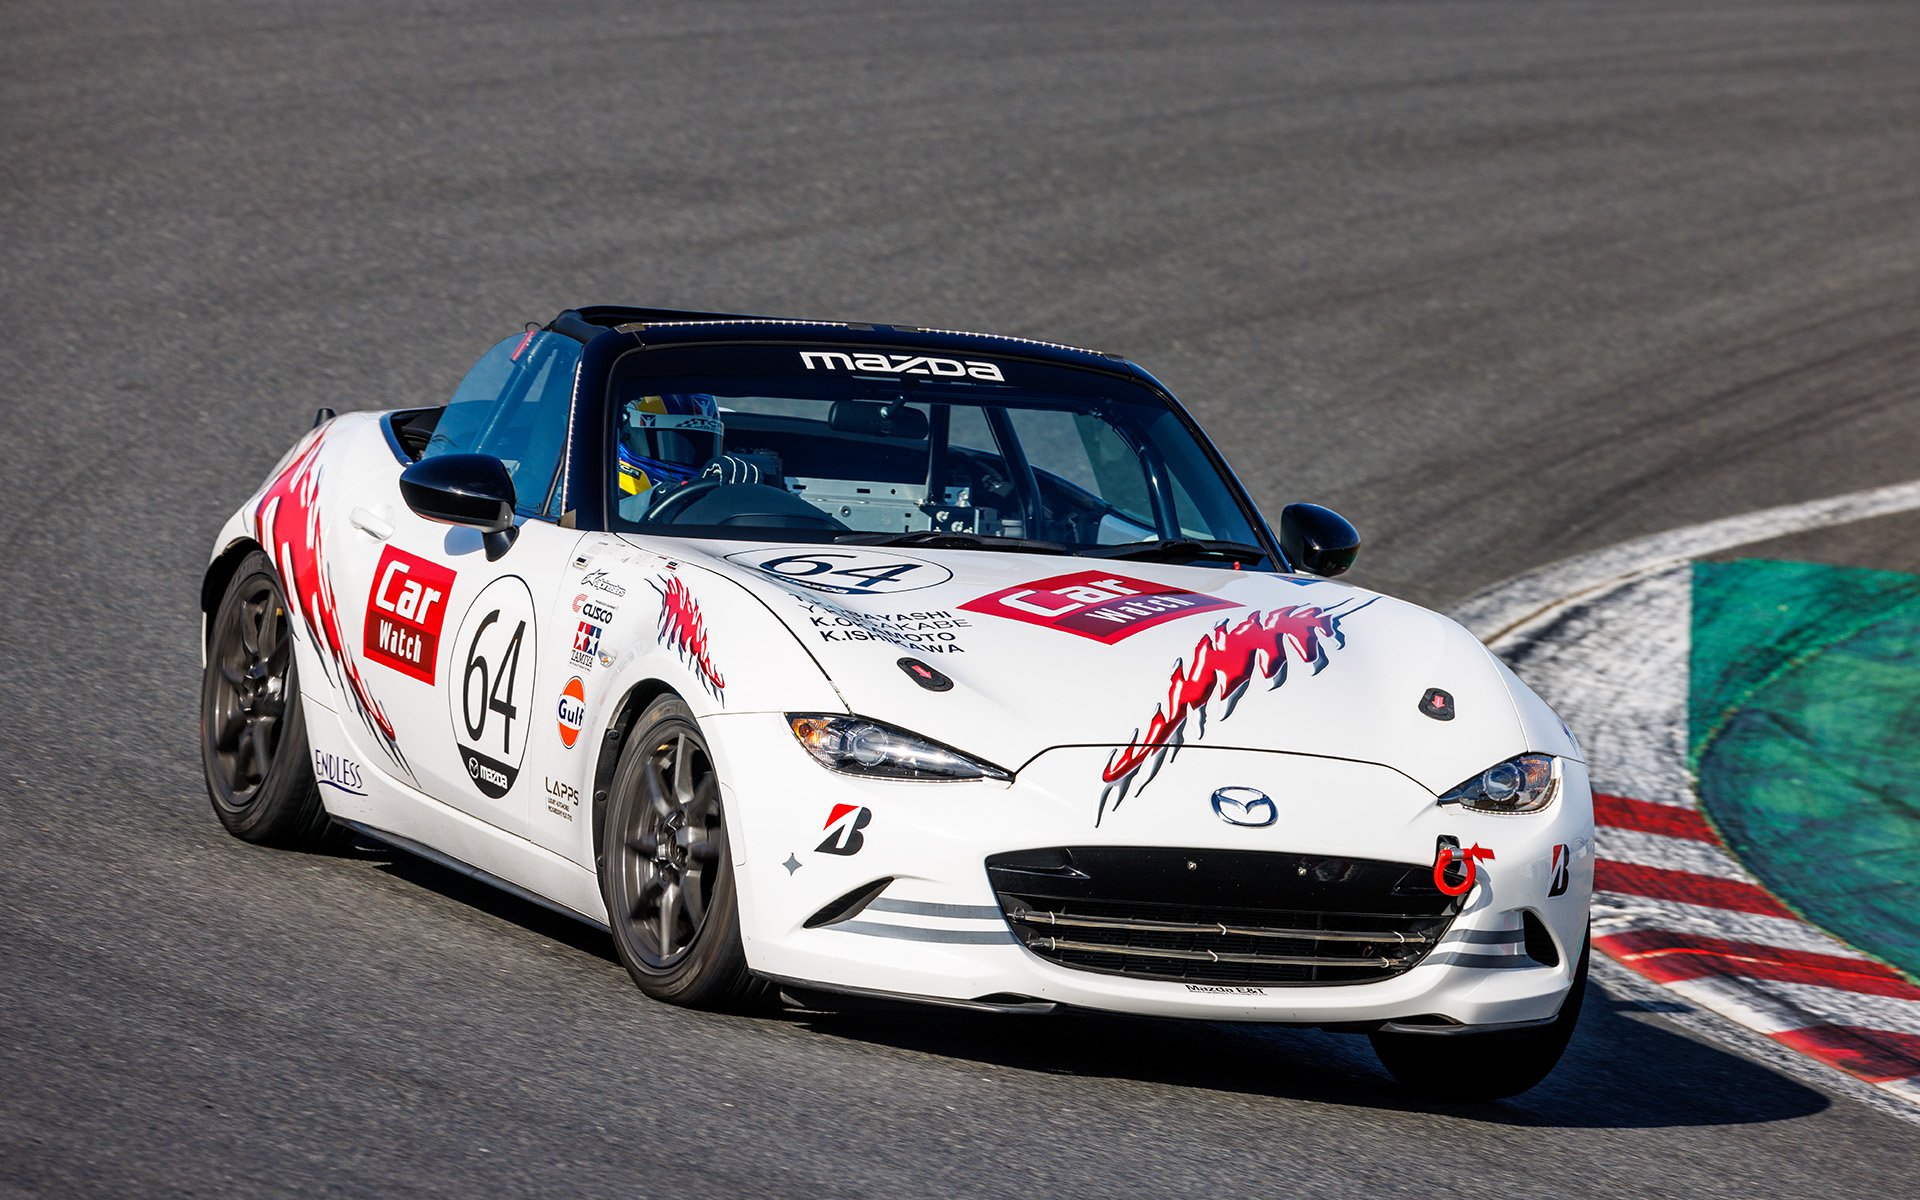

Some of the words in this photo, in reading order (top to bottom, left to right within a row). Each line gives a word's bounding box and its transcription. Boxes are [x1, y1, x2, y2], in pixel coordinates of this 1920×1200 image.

[758, 553, 924, 589] 64
[375, 559, 442, 625] Car
[998, 578, 1143, 618] Car
[582, 602, 613, 624] CUSCO
[1085, 594, 1196, 624] Watch
[379, 618, 422, 664] Watch
[570, 649, 594, 668] TAMIYA
[462, 608, 527, 755] 64
[558, 698, 585, 727] Gulf
[315, 748, 363, 789] ENDLESS
[545, 776, 579, 807] LAPPS
[1185, 984, 1235, 995] Mazda
